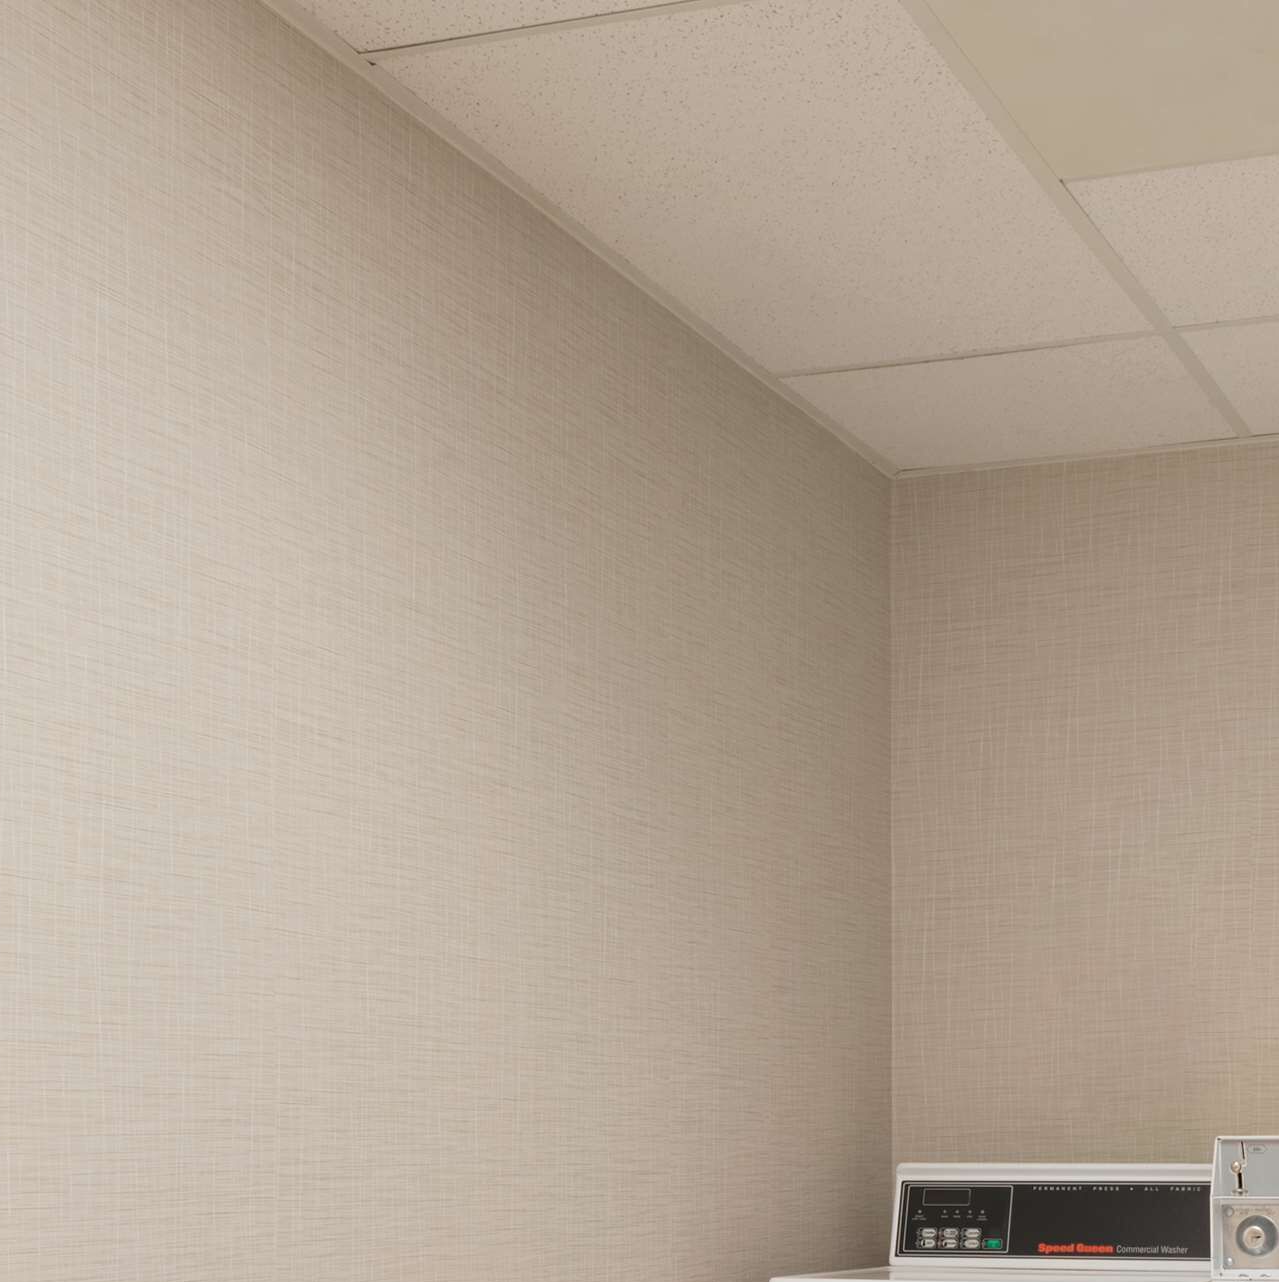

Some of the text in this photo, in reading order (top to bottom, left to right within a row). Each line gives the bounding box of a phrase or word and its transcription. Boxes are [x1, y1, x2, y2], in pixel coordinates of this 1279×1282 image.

[1038, 1243, 1188, 1254] Speed Queen Commercial Washer
